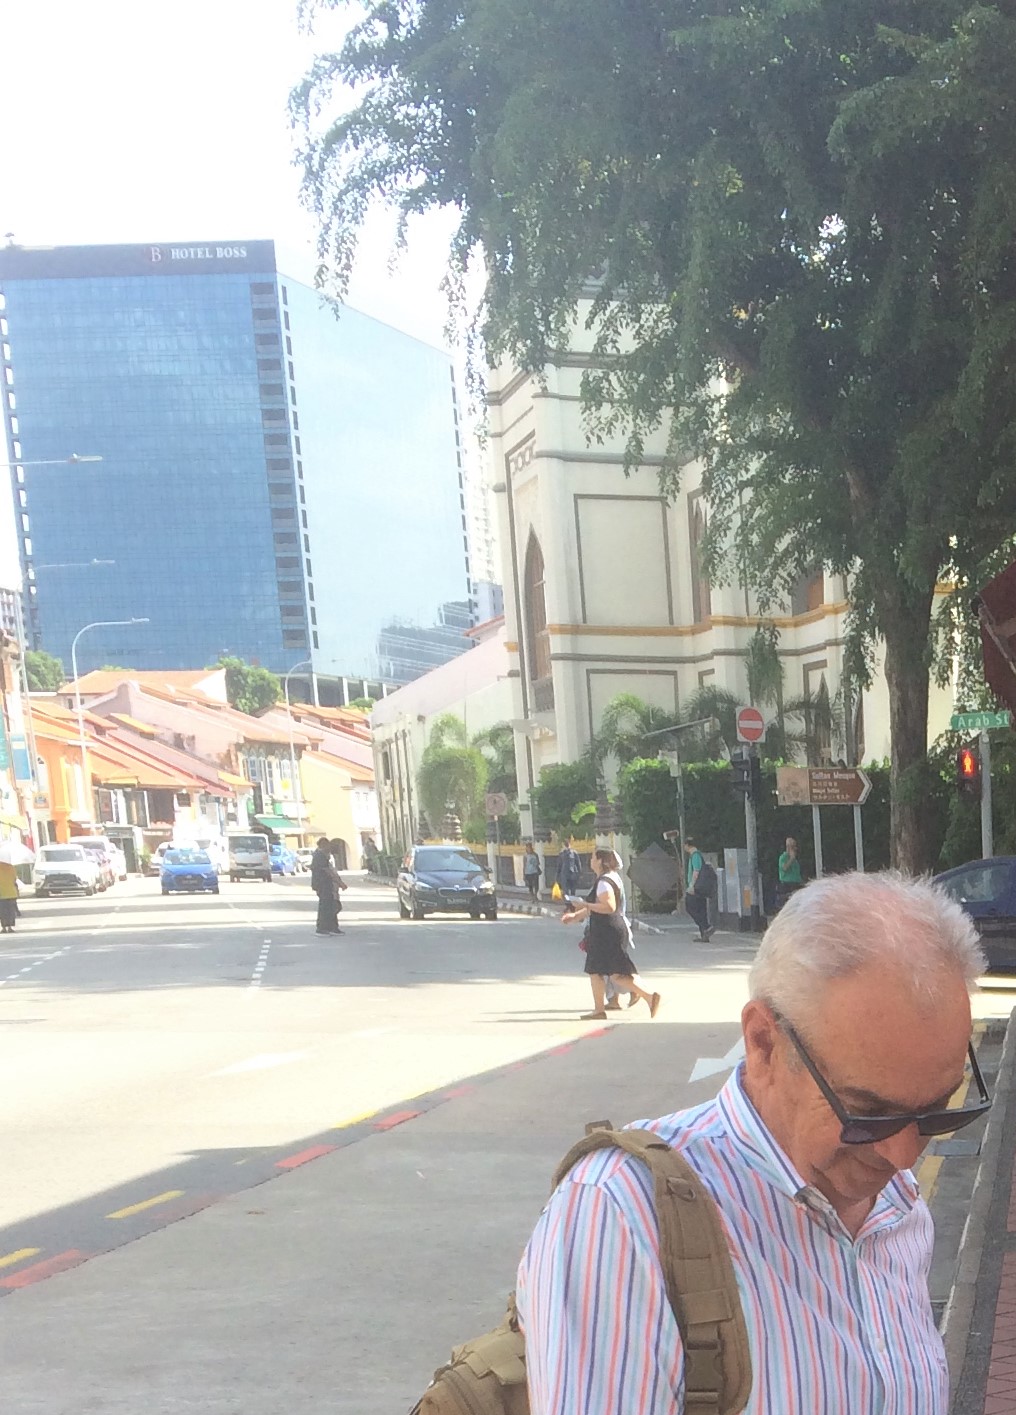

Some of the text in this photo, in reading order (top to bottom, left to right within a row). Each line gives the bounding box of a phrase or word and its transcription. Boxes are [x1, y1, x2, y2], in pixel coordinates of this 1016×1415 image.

[171, 247, 213, 259] HOTEL
[216, 246, 247, 258] BOSS
[958, 713, 1009, 728] Arab St
